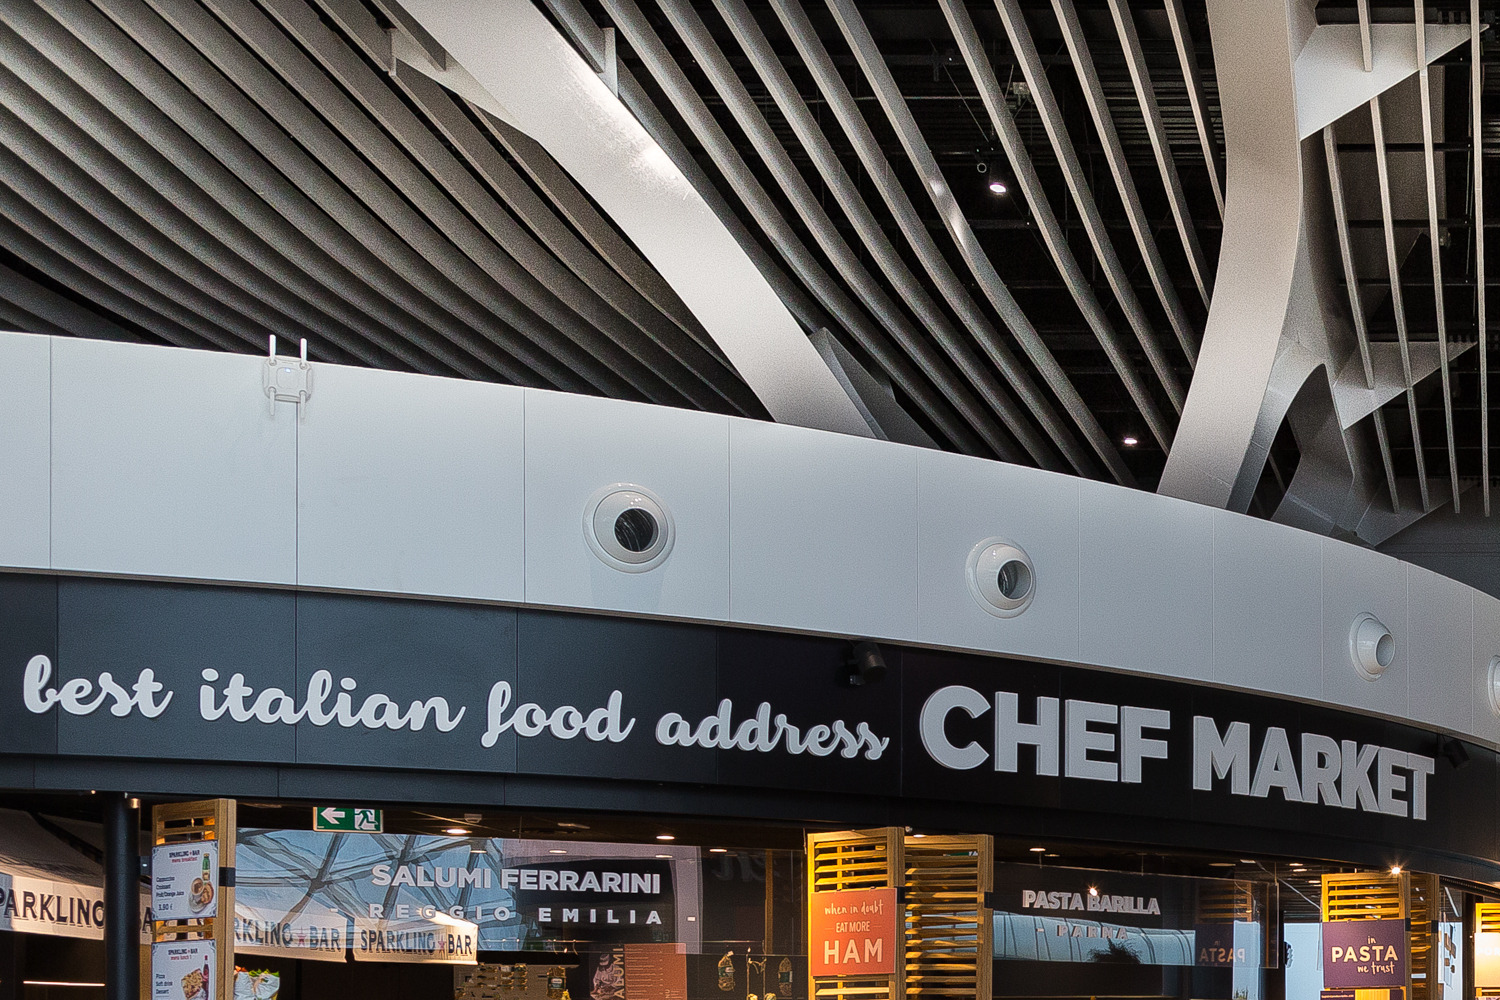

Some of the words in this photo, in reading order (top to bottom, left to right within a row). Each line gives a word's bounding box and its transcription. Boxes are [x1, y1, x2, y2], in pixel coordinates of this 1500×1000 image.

[23, 654, 174, 718] best
[199, 667, 467, 732] italian
[480, 680, 636, 748] food
[655, 698, 890, 760] address
[919, 685, 1171, 784] CHEF
[1192, 715, 1435, 821] MARKET
[371, 864, 492, 889] SALUMI
[501, 868, 661, 894] FERRARINI
[368, 903, 511, 921] REGGIO
[538, 907, 662, 925] EMILIA
[825, 902, 847, 915] when
[850, 903, 859, 915] in
[861, 899, 884, 916] doubt
[1022, 890, 1085, 911] PASTA
[1087, 893, 1161, 915] BARILLA
[836, 921, 848, 933] EAT
[849, 920, 870, 932] MORE
[1057, 924, 1129, 940] PARMA
[309, 925, 341, 952] BAR
[360, 929, 436, 955] SPARKLING
[448, 933, 473, 956] BAR
[1367, 935, 1376, 944] in
[824, 938, 883, 965] HAM
[1331, 945, 1398, 963] PASTA
[1357, 964, 1369, 973] we
[1371, 961, 1395, 975] trust
